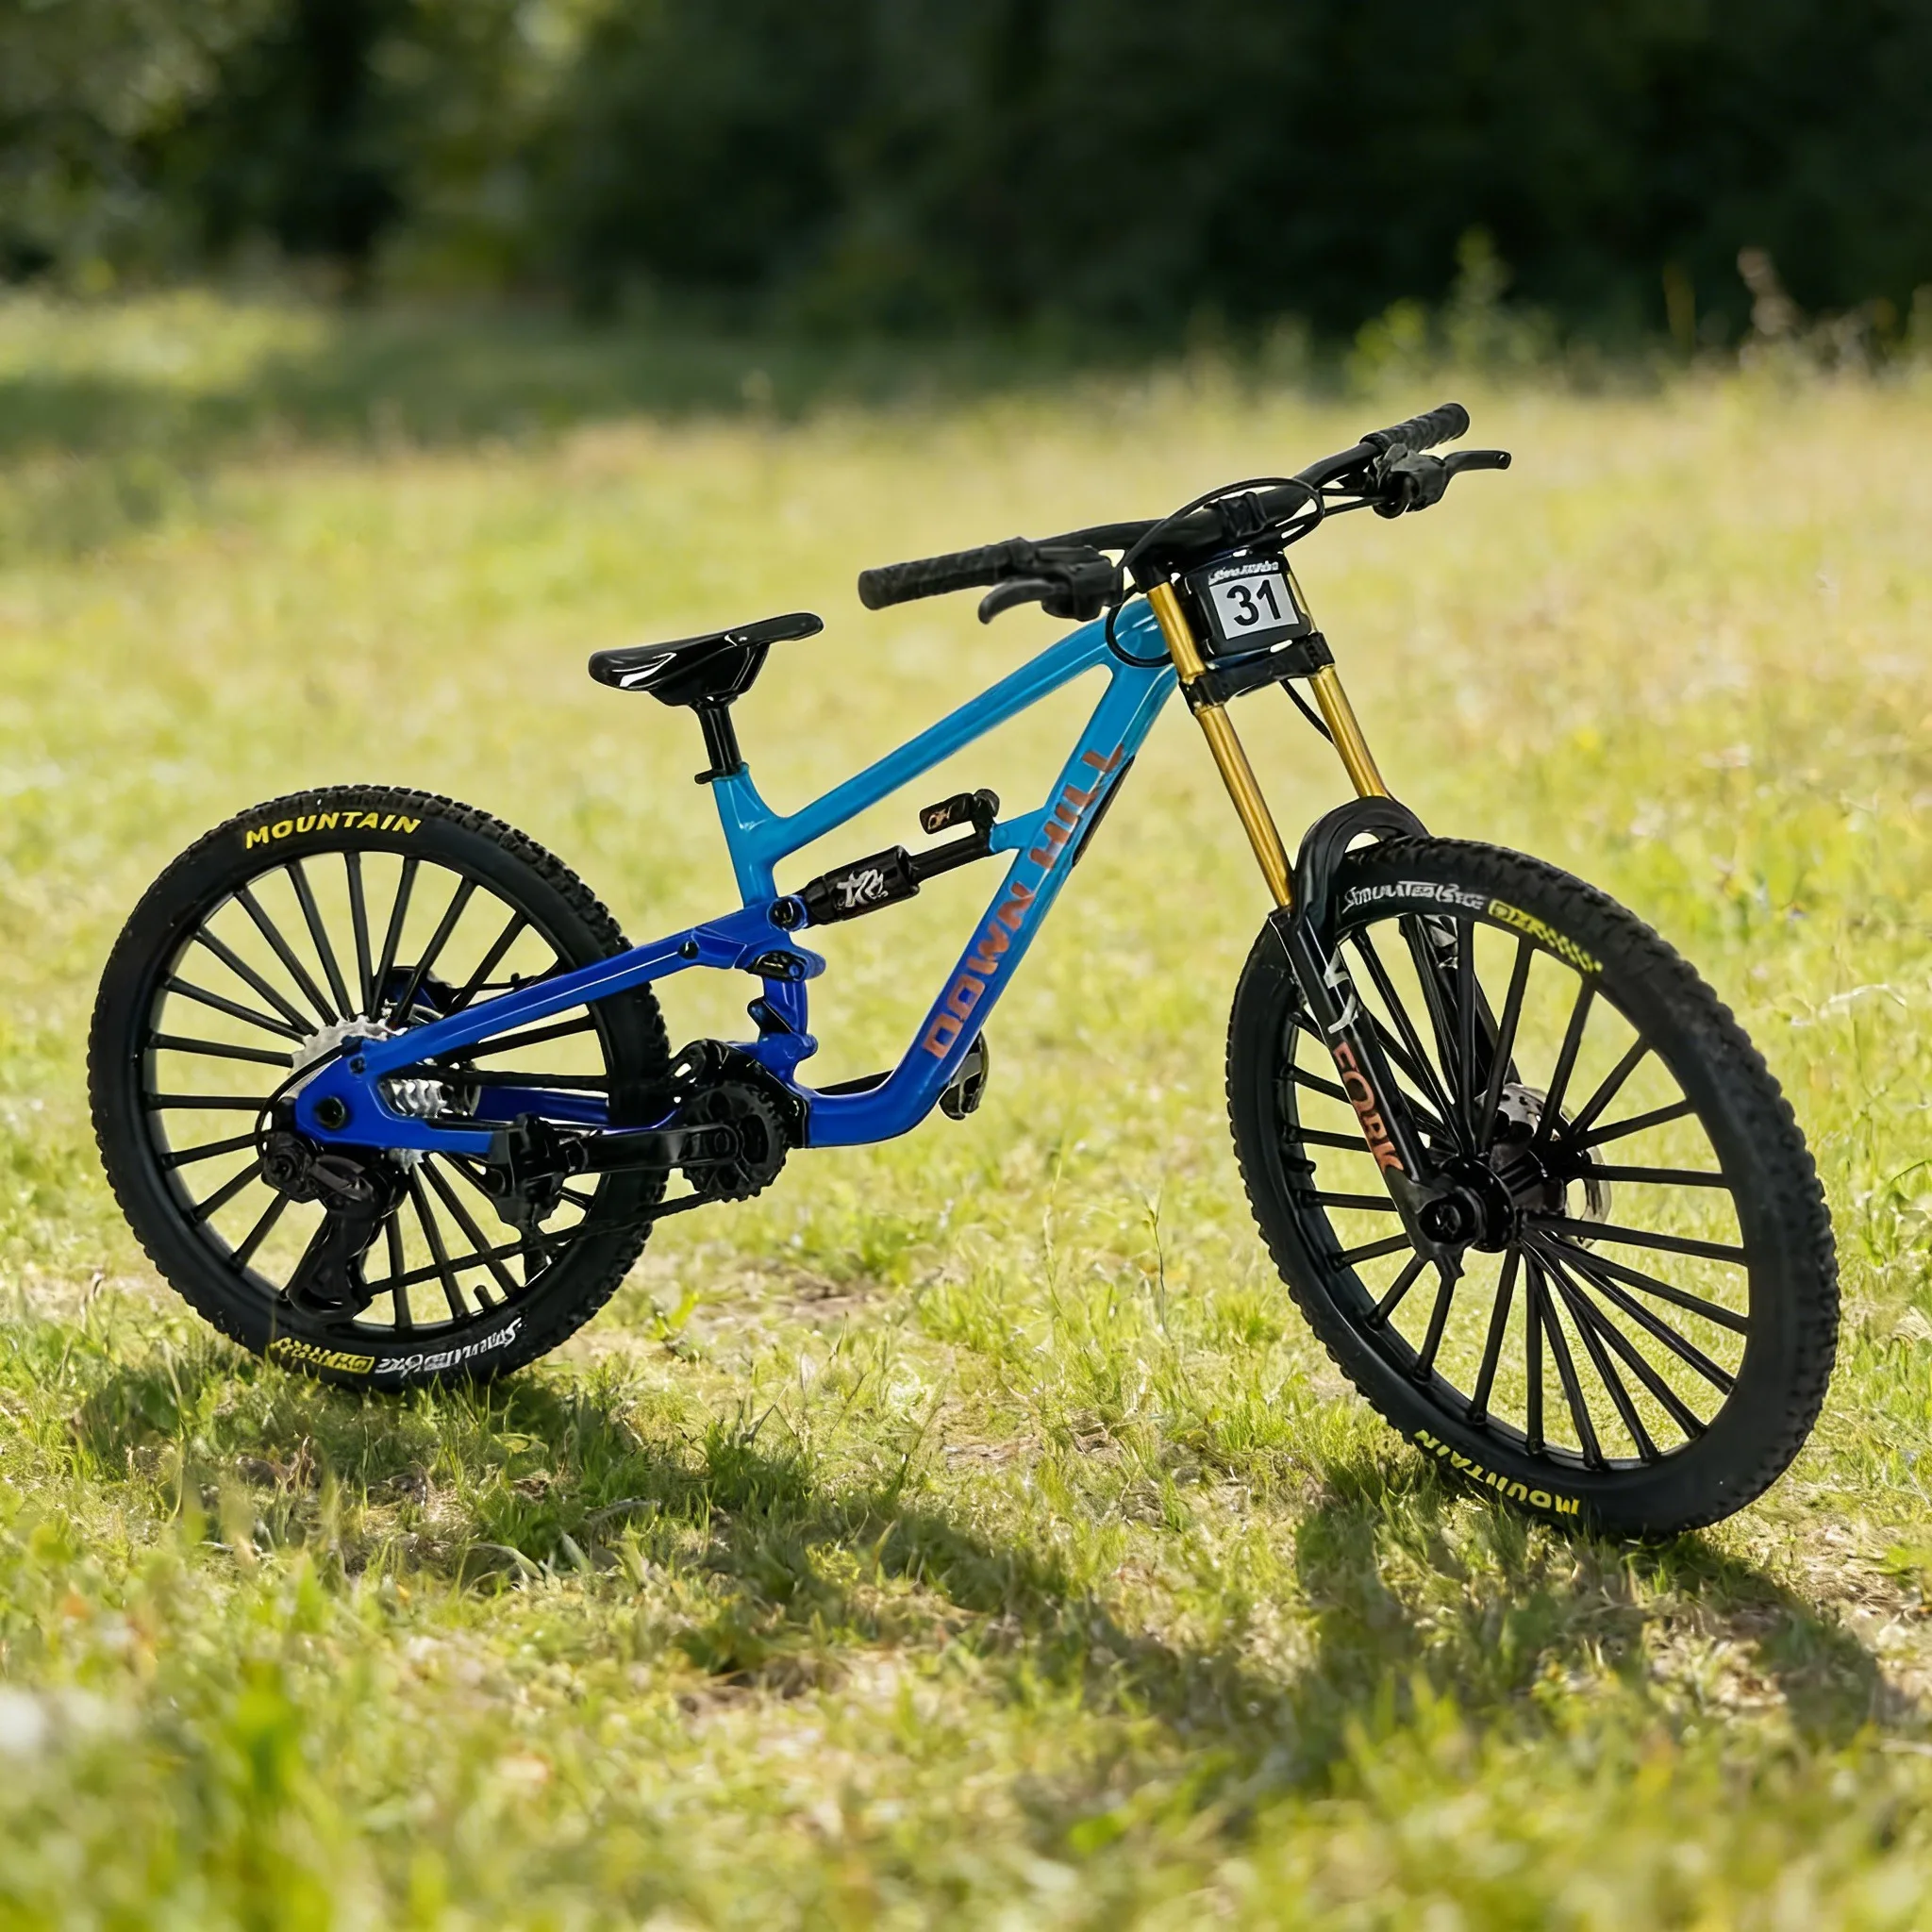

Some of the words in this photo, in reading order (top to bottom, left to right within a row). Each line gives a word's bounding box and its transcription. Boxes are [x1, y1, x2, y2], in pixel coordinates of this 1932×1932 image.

[1226, 579, 1282, 626] 31
[245, 811, 422, 849] MOUNTAIN
[922, 880, 1037, 1059] DOWN
[1029, 743, 1124, 871] HILL
[1414, 1429, 1580, 1515] MOUNTAIN
